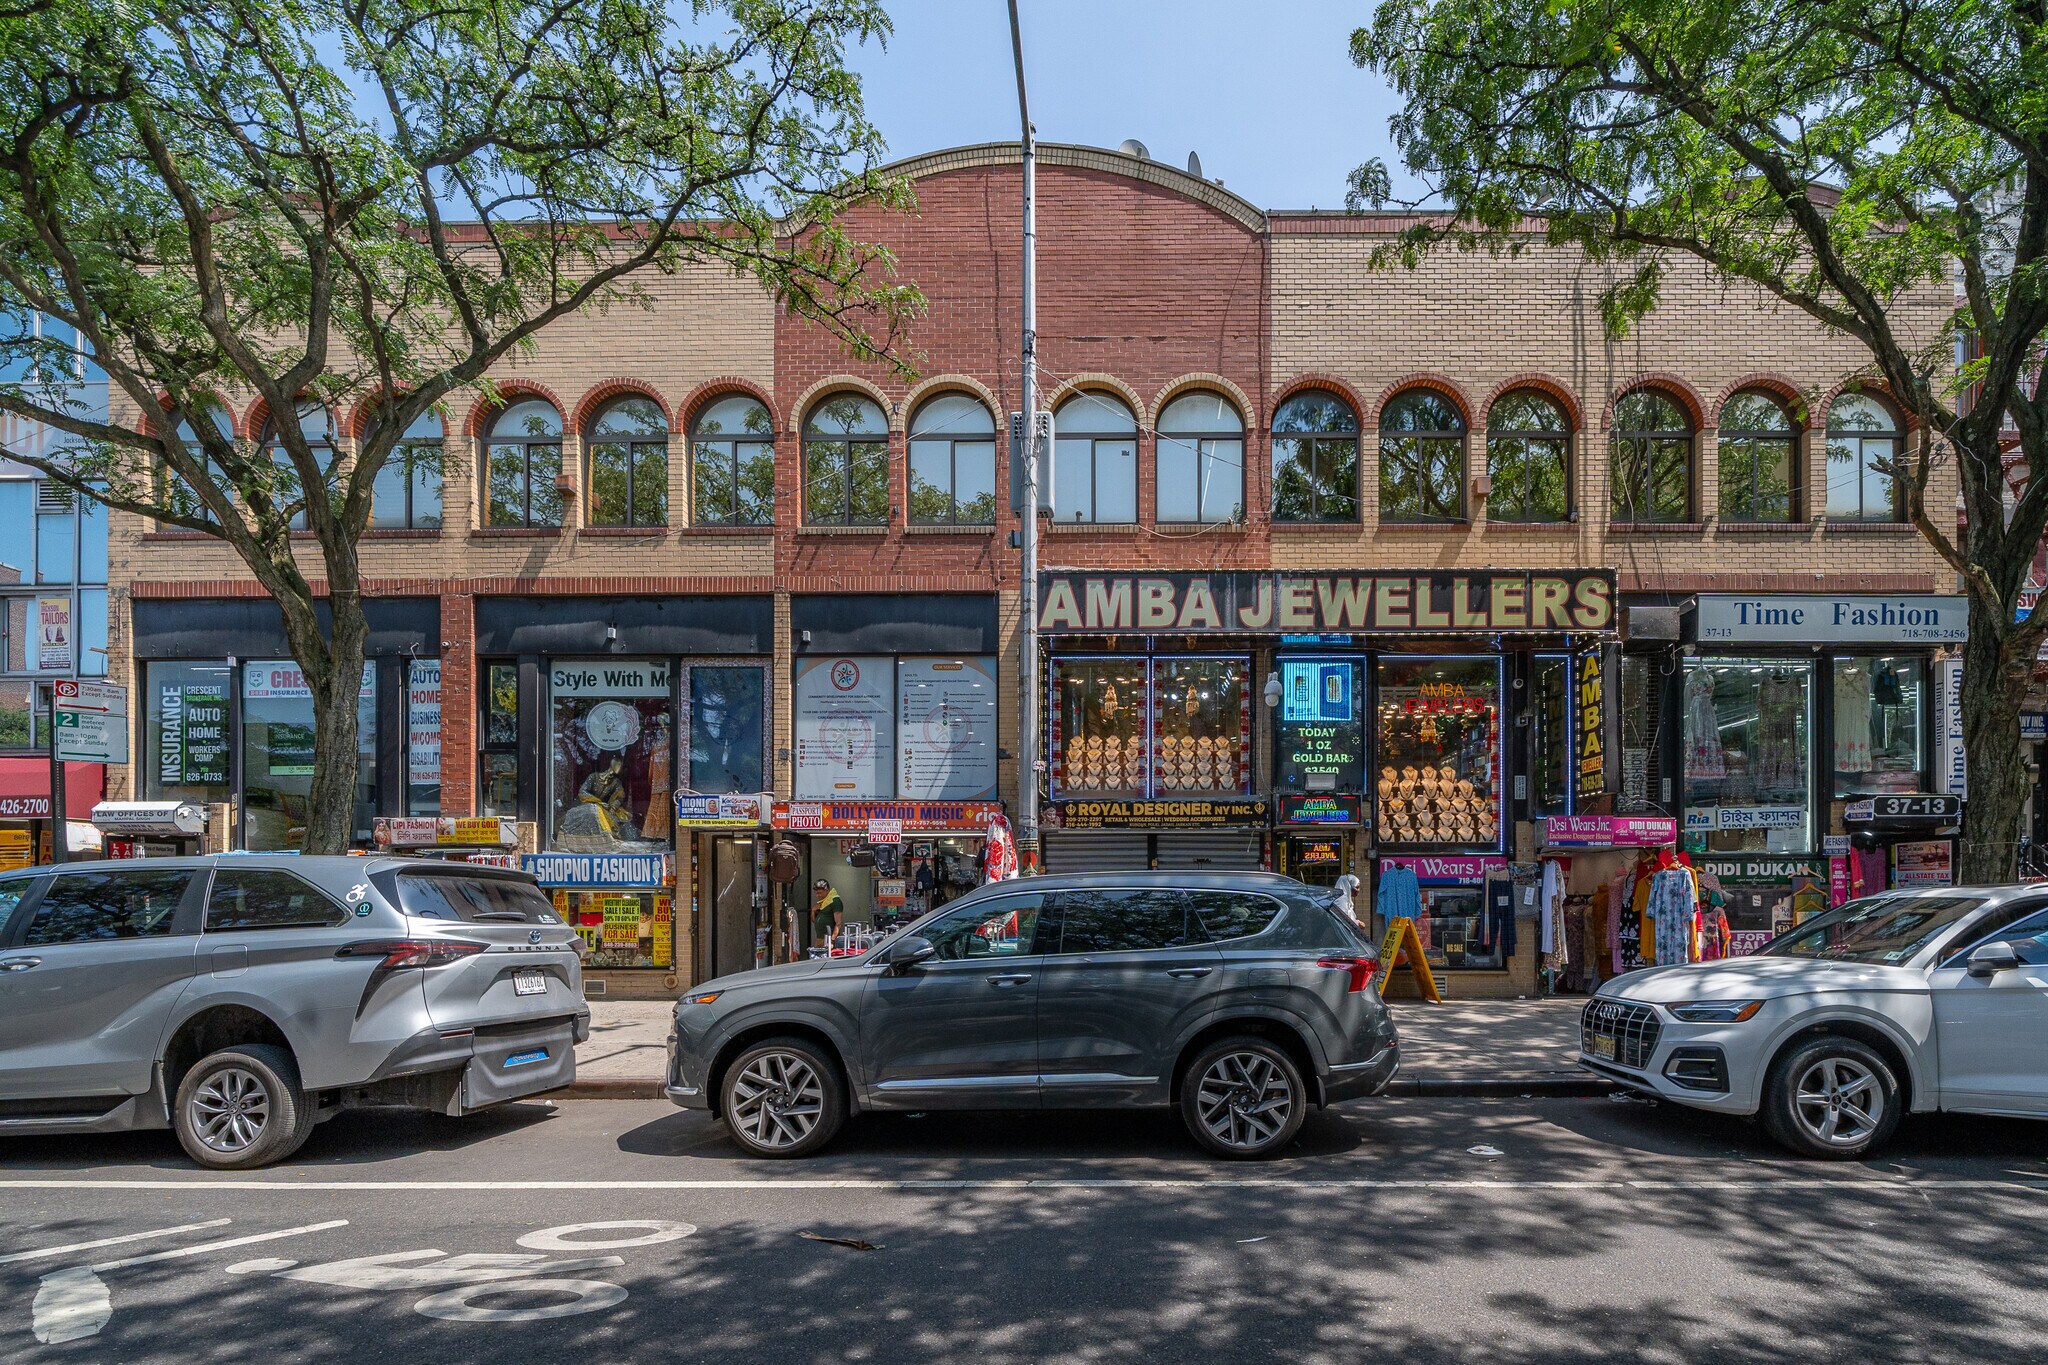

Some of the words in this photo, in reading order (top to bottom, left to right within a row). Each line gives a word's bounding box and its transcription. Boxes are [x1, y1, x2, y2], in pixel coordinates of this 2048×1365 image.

[1037, 578, 1223, 629] AMBA
[1238, 576, 1613, 629] JEWELLERS
[41, 611, 69, 625] TAILORS
[1734, 602, 1805, 626] Time
[1831, 602, 1940, 626] Fashion
[1705, 628, 1732, 638] 37-13
[1902, 629, 1966, 639] 718-708-2456
[411, 671, 441, 684] AUTO
[554, 670, 598, 691] Style
[604, 670, 643, 687] With
[186, 686, 222, 695] CRESCENT
[1420, 682, 1465, 697] AMBA
[411, 690, 441, 704] HOME
[1582, 655, 1601, 757] AMBA
[61, 713, 74, 727] 2
[188, 708, 221, 722] AUTO
[162, 686, 181, 782] INSURANCE
[188, 727, 221, 739] HOME
[1298, 728, 1336, 737] TODAY
[188, 745, 221, 754] WORKERS
[1306, 741, 1313, 750] 1
[1316, 741, 1332, 750] OZ
[194, 754, 214, 762] COMP
[1292, 753, 1323, 763] GOLD
[1326, 753, 1349, 763] BAR
[422, 772, 441, 780] 626-073
[1949, 745, 1965, 794] Time
[0, 799, 49, 814] 426-2700
[682, 798, 705, 808] MONI
[1078, 803, 1131, 816] ROYAL
[1133, 803, 1212, 816] DESIGNER
[1215, 806, 1230, 815] NY
[1232, 806, 1253, 815] INC.
[1886, 798, 1946, 815] 37-13
[792, 806, 819, 815] PASSPORT
[832, 806, 915, 820] BOLLYWOOD
[920, 807, 964, 820] MUSIC
[1720, 809, 1753, 824] টাইম
[791, 816, 820, 827] PHOTO
[1549, 816, 1567, 832] Desi
[1569, 816, 1596, 832] Wears
[1629, 821, 1645, 831] DIDI
[1646, 821, 1672, 831] DUKAN
[1687, 811, 1710, 825] Ria
[392, 821, 405, 829] LIPI
[407, 821, 435, 829] FASHION
[456, 821, 466, 829] WE
[467, 821, 480, 829] BUY
[482, 821, 498, 829] GOLD
[870, 833, 899, 842] PHOTO
[1572, 833, 1595, 841] Designer
[536, 858, 590, 883] SHOPNO
[593, 858, 651, 882] FASHION
[1381, 859, 1417, 875] Dsi
[1421, 858, 1474, 876] Wears
[1705, 863, 1741, 876] DIDI
[1746, 863, 1809, 876] DUKAN
[604, 930, 618, 939] FOR
[620, 930, 637, 939] SALE
[1736, 933, 1766, 941] FOR
[1454, 943, 1464, 952] SALE
